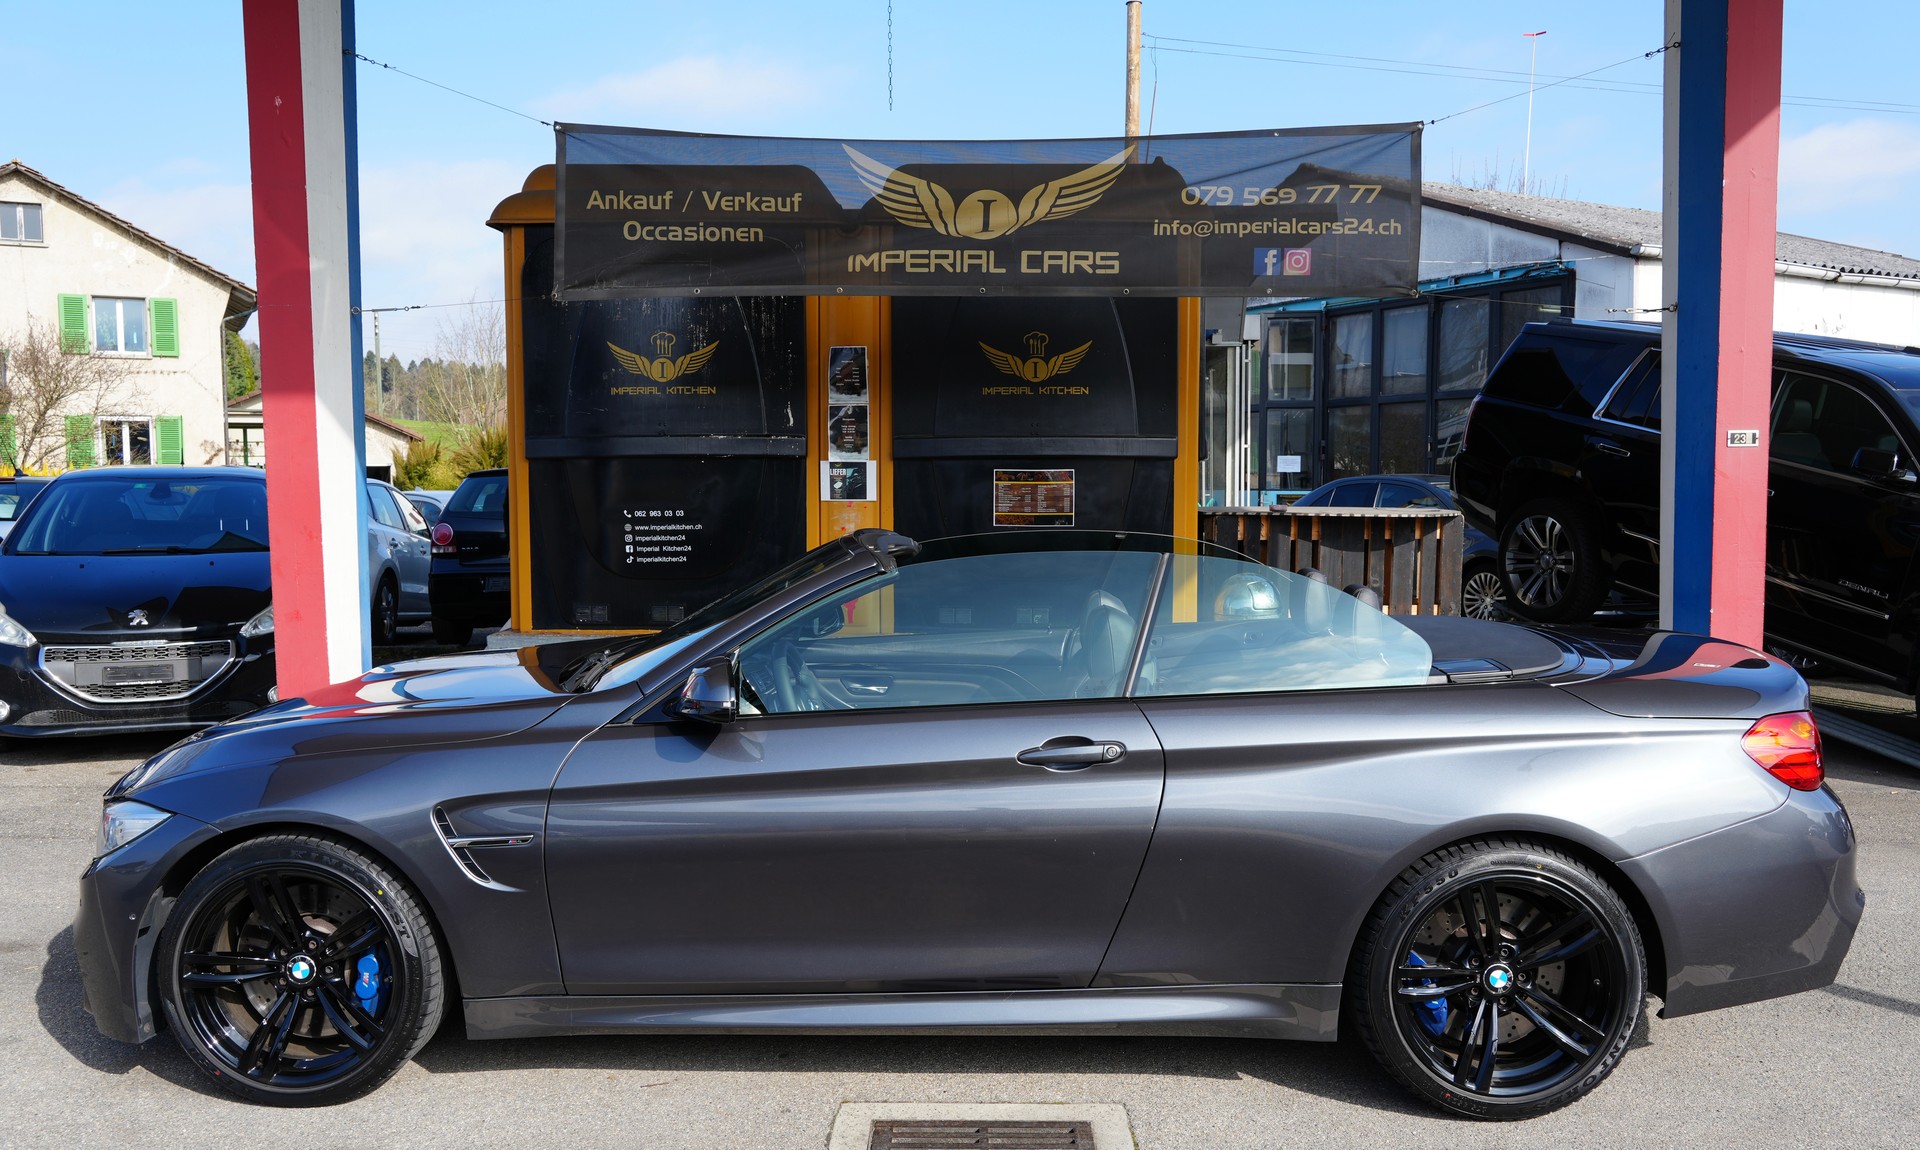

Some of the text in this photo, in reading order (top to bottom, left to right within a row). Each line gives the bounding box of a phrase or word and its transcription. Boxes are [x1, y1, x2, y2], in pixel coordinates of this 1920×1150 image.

[586, 190, 802, 213] Ankauf / Verkauf
[1181, 185, 1382, 207] 079 569 77 77
[623, 220, 764, 242] Occasionen
[1154, 218, 1402, 238] info@imperialcars24.ch
[847, 249, 1120, 274] IMPERIAL CARS
[610, 385, 717, 396] IMPERIAL KITCHEN
[982, 386, 1089, 396] IMPERIAL KITCHEN
[1733, 433, 1746, 444] 23
[634, 523, 703, 532] www.imperialkitchen.ch
